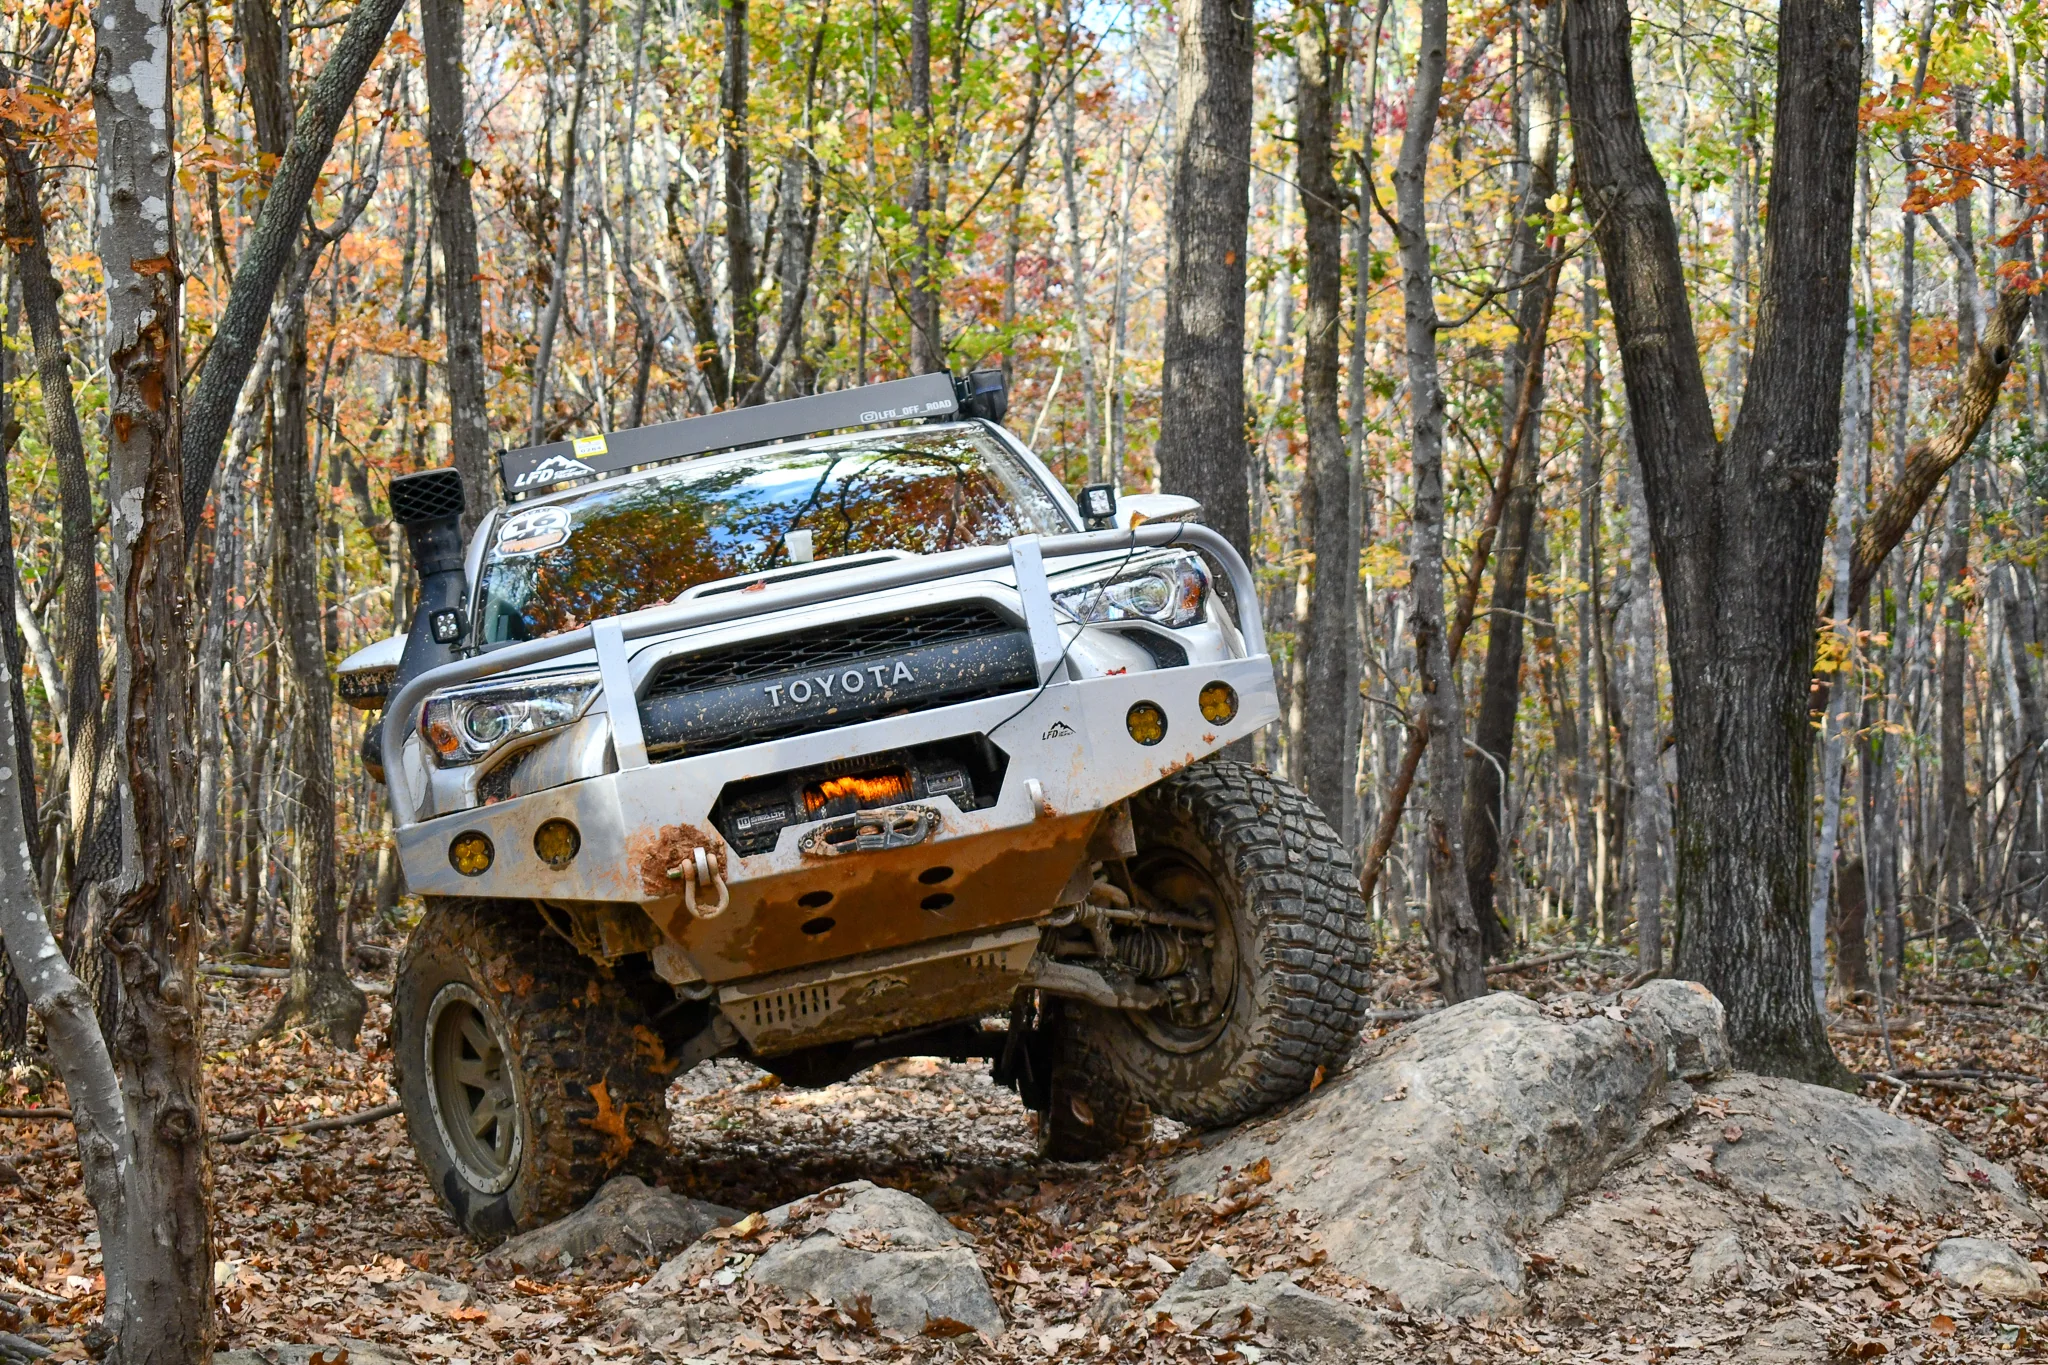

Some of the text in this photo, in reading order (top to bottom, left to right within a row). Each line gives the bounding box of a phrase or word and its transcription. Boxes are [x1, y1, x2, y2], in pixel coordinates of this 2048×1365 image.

[878, 399, 952, 419] LFD_OFF_ROAD
[514, 469, 554, 487] LFD
[512, 513, 557, 532] 16
[763, 660, 915, 708] TOYOTA
[1041, 729, 1059, 741] LFD
